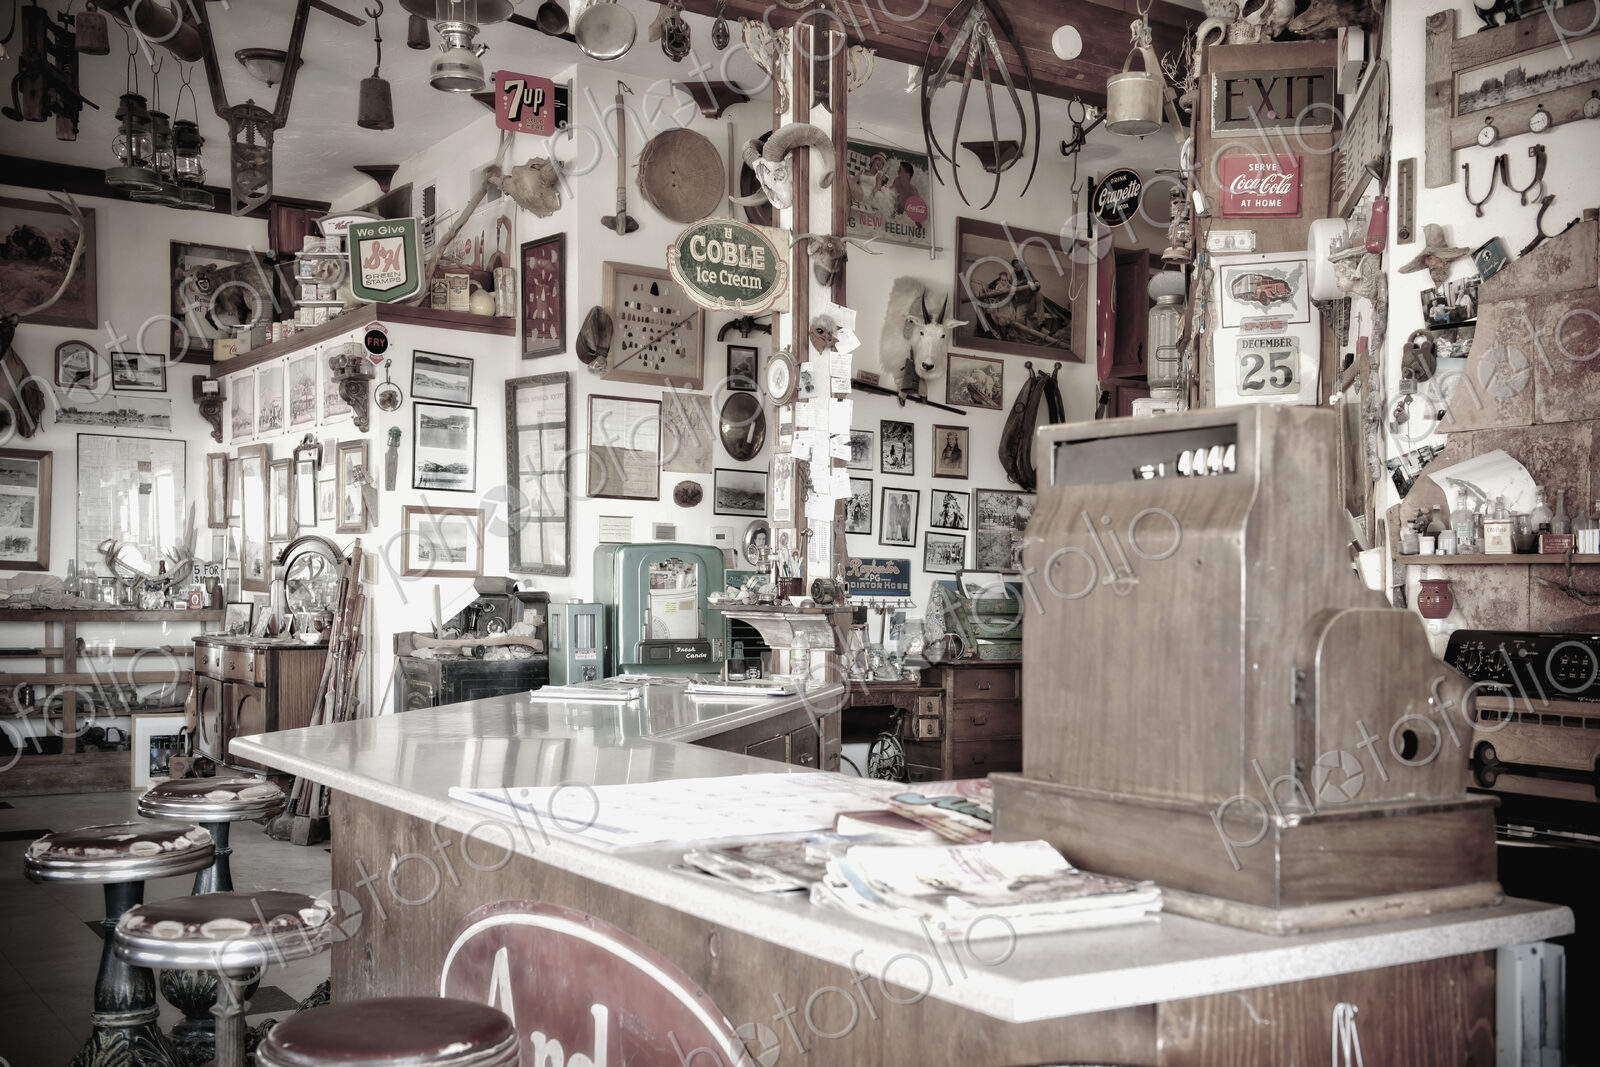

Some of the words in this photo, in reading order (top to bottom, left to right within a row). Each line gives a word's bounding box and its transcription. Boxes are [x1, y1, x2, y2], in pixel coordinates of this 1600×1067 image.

[1223, 75, 1325, 122] EXIT
[1249, 163, 1277, 171] SERVE
[1110, 175, 1127, 184] DRINK
[1096, 180, 1141, 217] Grapette
[1241, 199, 1252, 207] AT
[1255, 199, 1282, 207] HOME
[356, 228, 375, 237] We
[378, 226, 405, 235] Give
[859, 214, 882, 228] NEW
[884, 221, 926, 239] FEELING!
[689, 234, 766, 271] COBLE
[365, 272, 401, 280] GREEN
[365, 277, 402, 285] STAMPS
[696, 267, 717, 284] Ice
[720, 270, 763, 290] Cream
[1242, 337, 1293, 349] DECEMBER
[1240, 352, 1293, 391] 25
[194, 565, 201, 575] 5
[204, 564, 220, 575] FOR
[870, 574, 881, 582] PG
